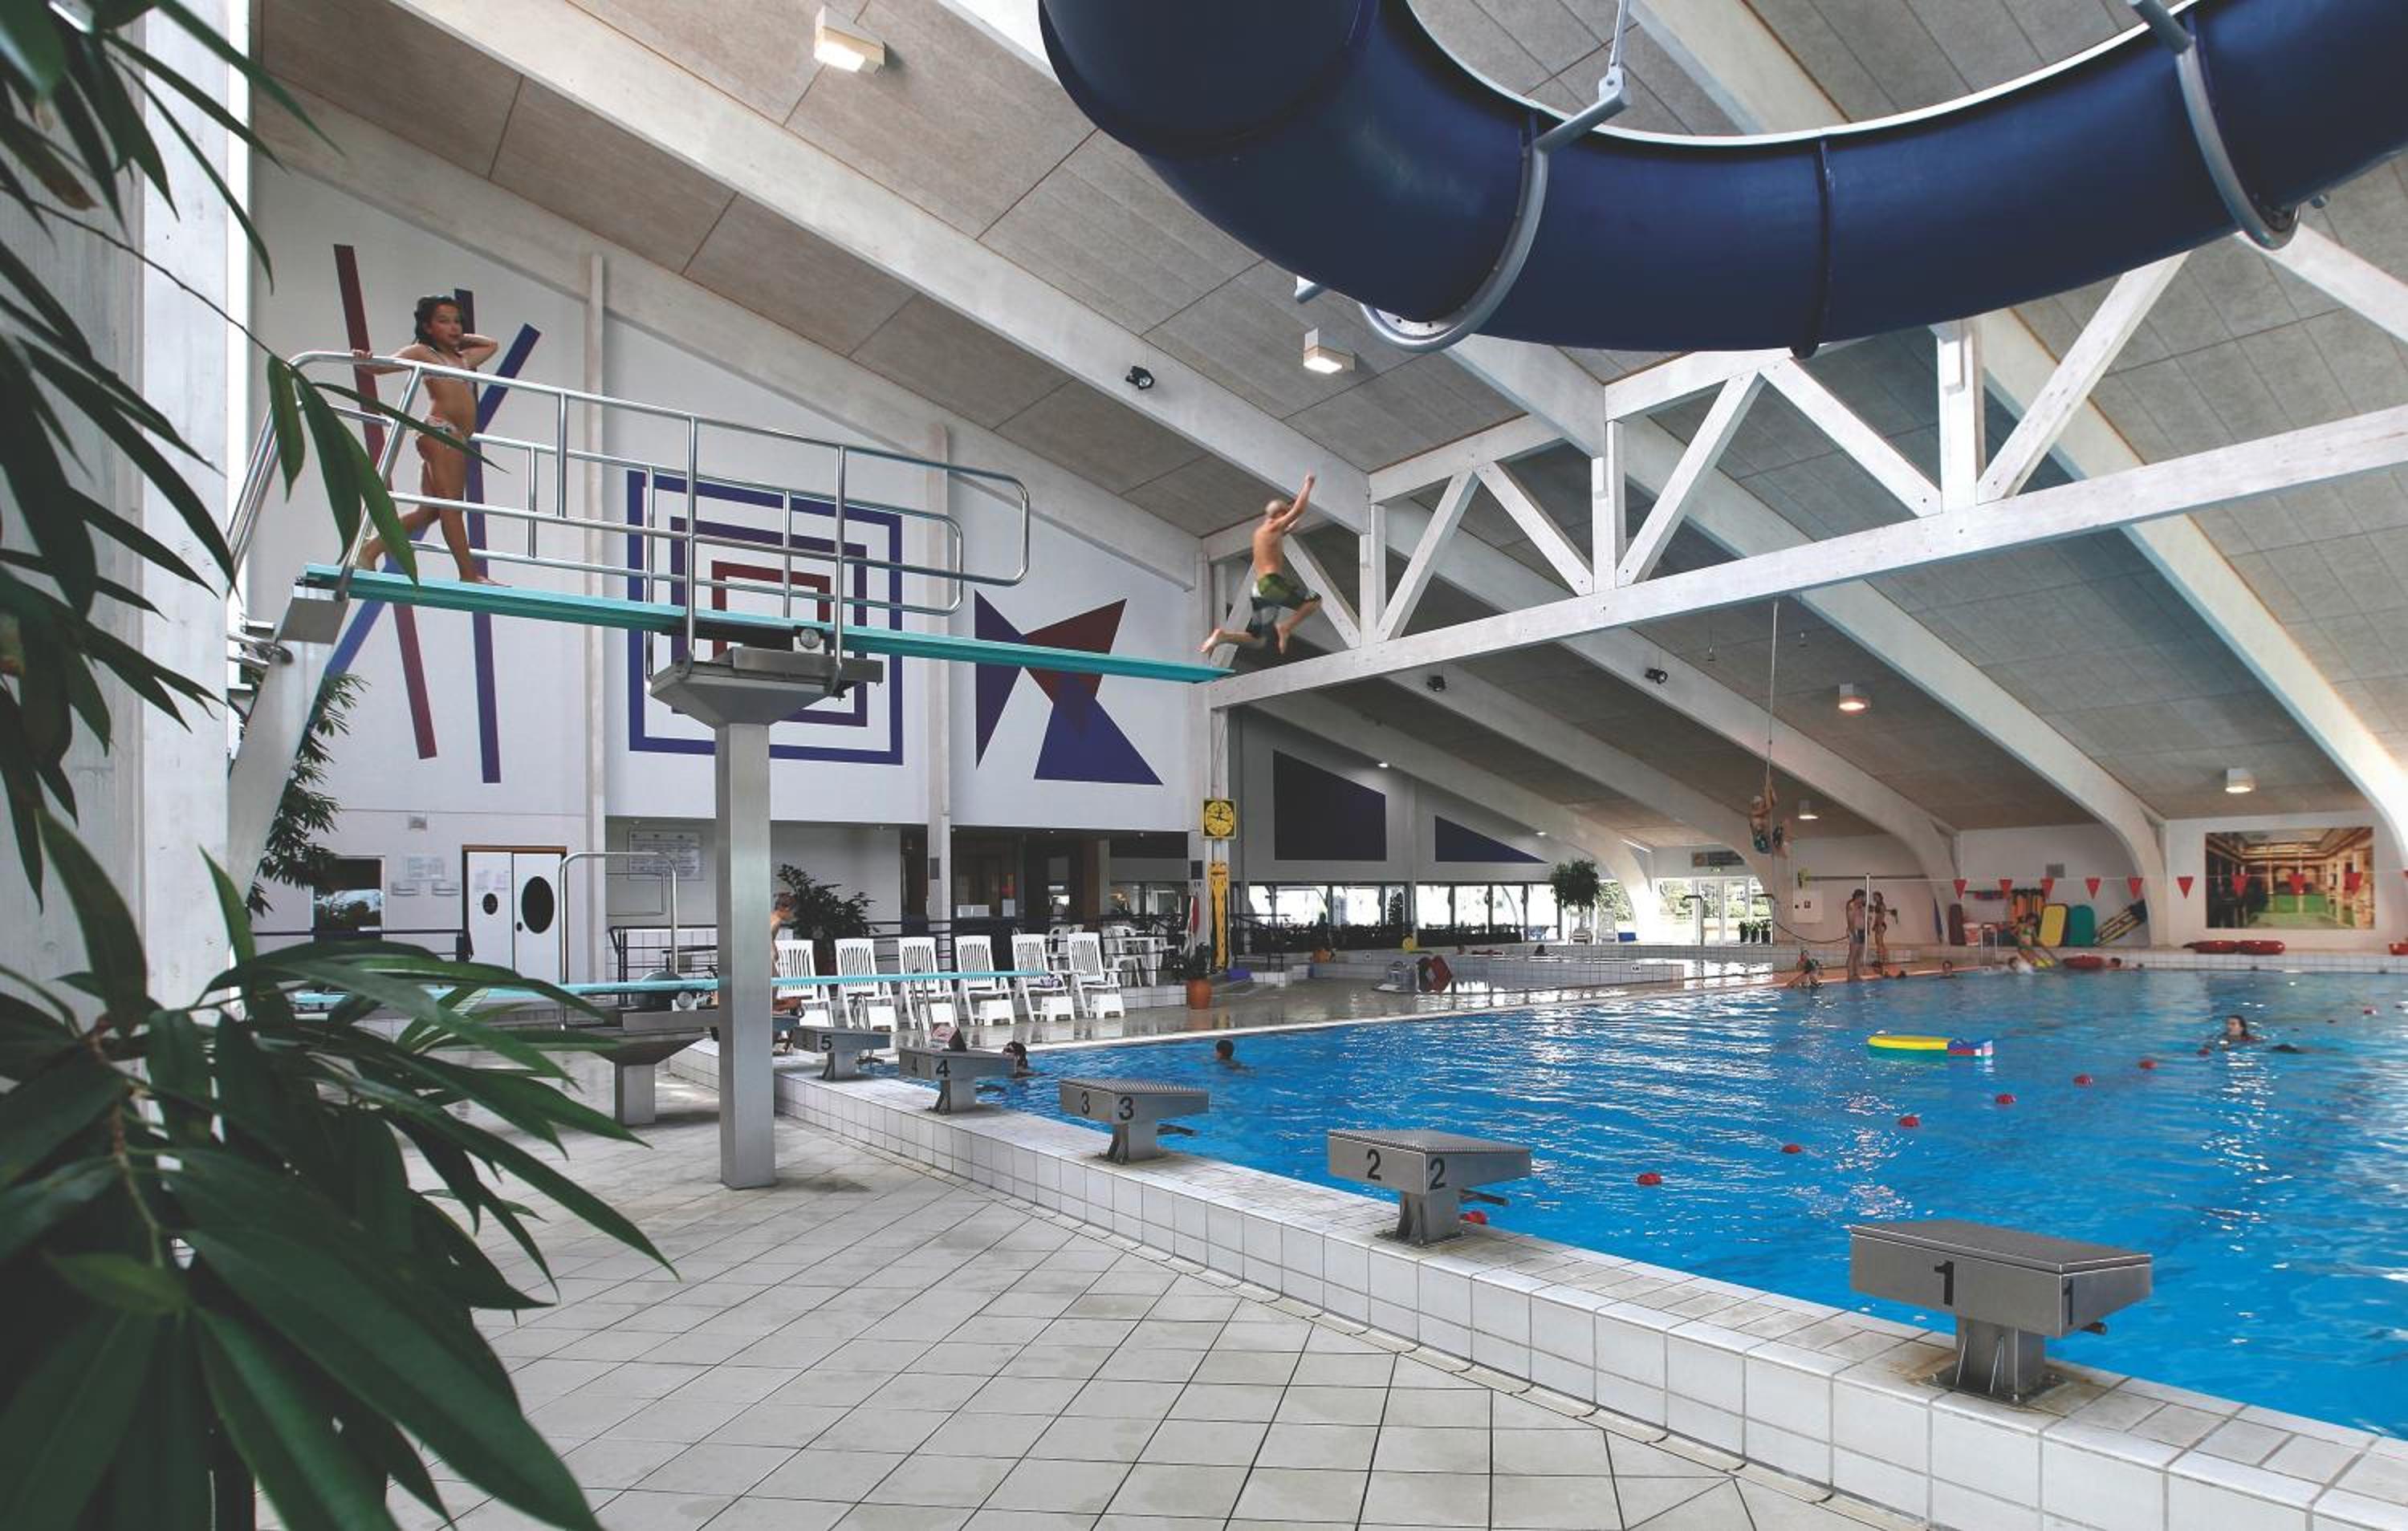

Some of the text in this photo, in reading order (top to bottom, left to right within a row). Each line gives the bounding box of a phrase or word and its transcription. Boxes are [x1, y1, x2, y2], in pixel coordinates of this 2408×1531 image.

[821, 1034, 832, 1050] 5
[935, 1058, 950, 1077] 4
[1081, 1090, 1091, 1115] 3
[1118, 1096, 1134, 1120] 3
[1367, 1148, 1381, 1181] 2
[1429, 1157, 1446, 1190] 2
[1934, 1260, 1954, 1306] 1
[2063, 1277, 2074, 1326] 1
